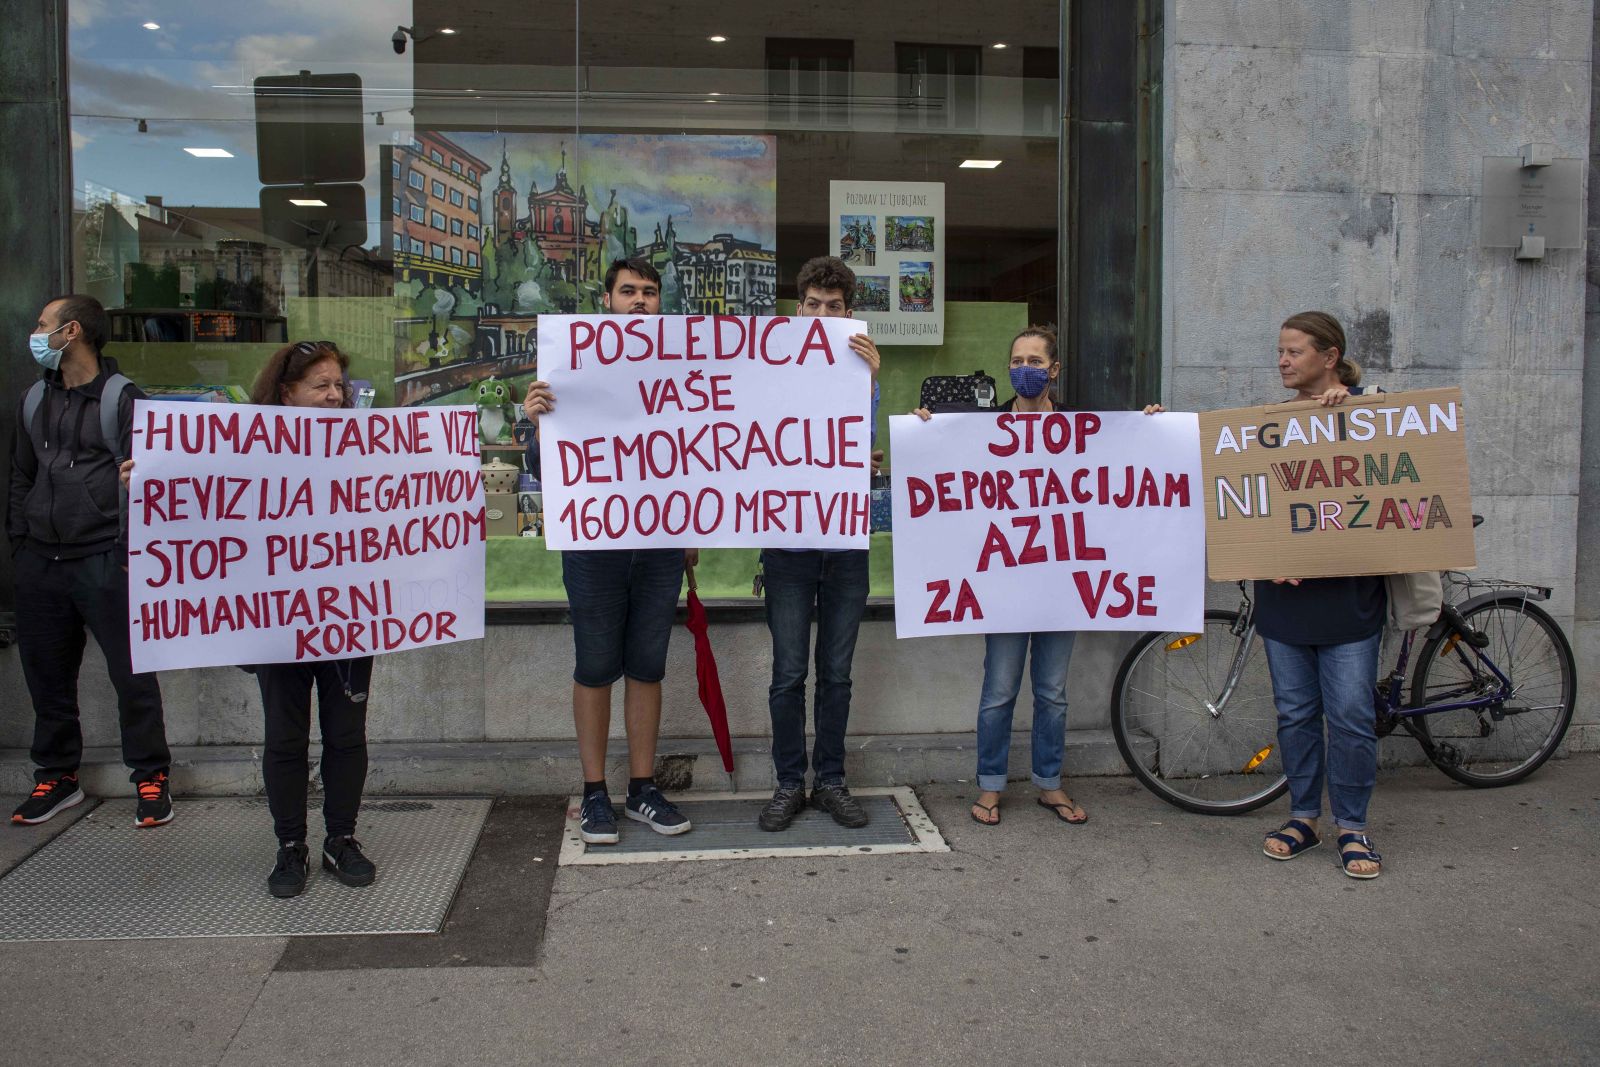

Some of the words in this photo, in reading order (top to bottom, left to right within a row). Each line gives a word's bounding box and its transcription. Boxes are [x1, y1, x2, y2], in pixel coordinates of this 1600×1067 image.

[846, 192, 877, 205] POZDRAV
[570, 315, 835, 370] POSLEDICA
[876, 324, 897, 335] FROM
[638, 370, 735, 415] VAŠE
[557, 416, 865, 487] DEMOKRACIJE
[988, 412, 1102, 457] STOP
[1214, 402, 1458, 456] AFGANISTAN
[329, 469, 482, 514] NEGATIVOV
[559, 487, 724, 542] 160000
[735, 490, 870, 537] MRTVIH
[907, 465, 1191, 518] DEPORTACIJAM
[1215, 473, 1271, 520] NI
[1289, 493, 1452, 534] DRŽAVA
[265, 506, 487, 576] PUSHBACKOM
[976, 511, 1107, 572] AZIL
[923, 578, 984, 624] ZA
[1072, 569, 1158, 619] VSE
[295, 610, 457, 660] KORIDOR
